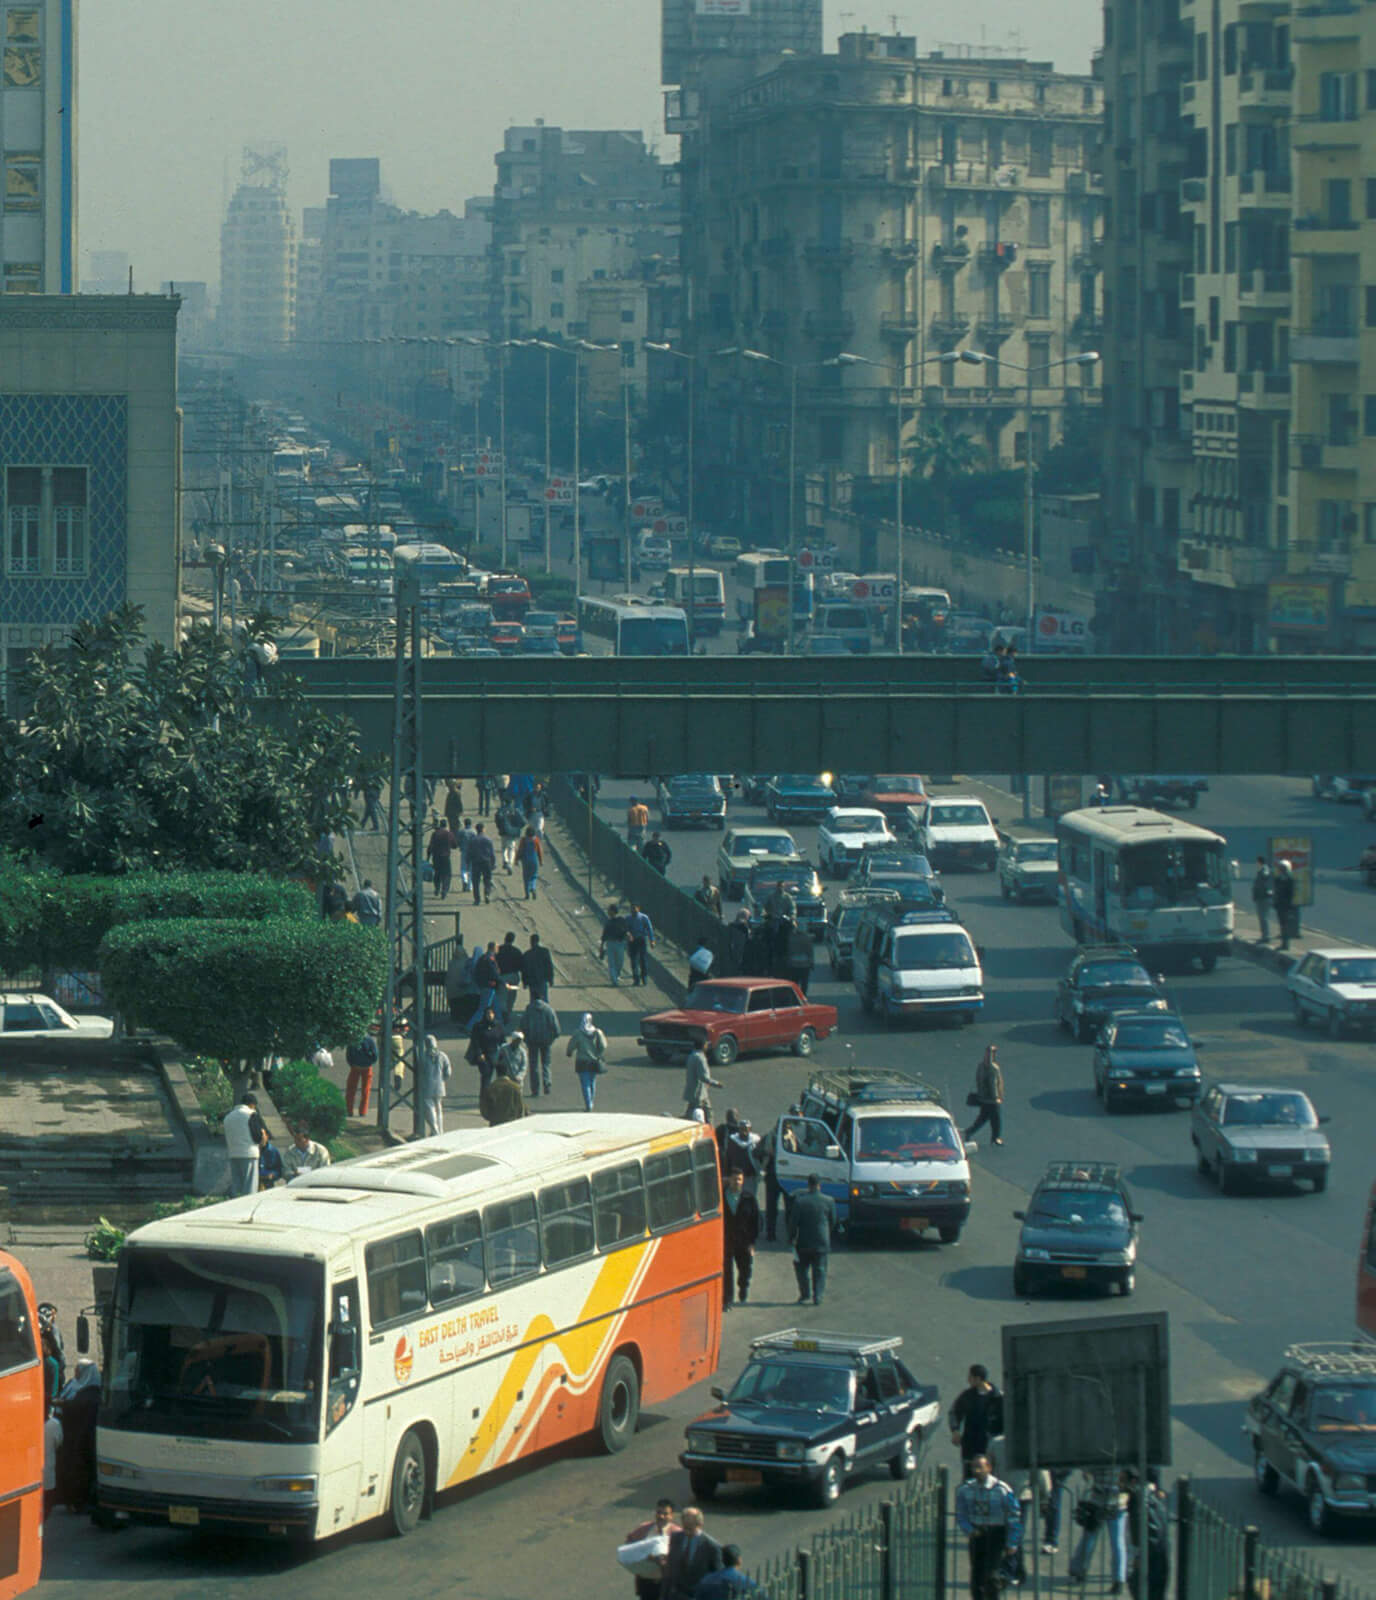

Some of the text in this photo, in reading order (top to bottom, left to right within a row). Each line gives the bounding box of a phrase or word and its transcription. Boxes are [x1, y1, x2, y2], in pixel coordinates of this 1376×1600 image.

[871, 585, 893, 597] LG
[1060, 619, 1084, 635] LG
[418, 1304, 499, 1348] EAST DELTA TRAVEL
